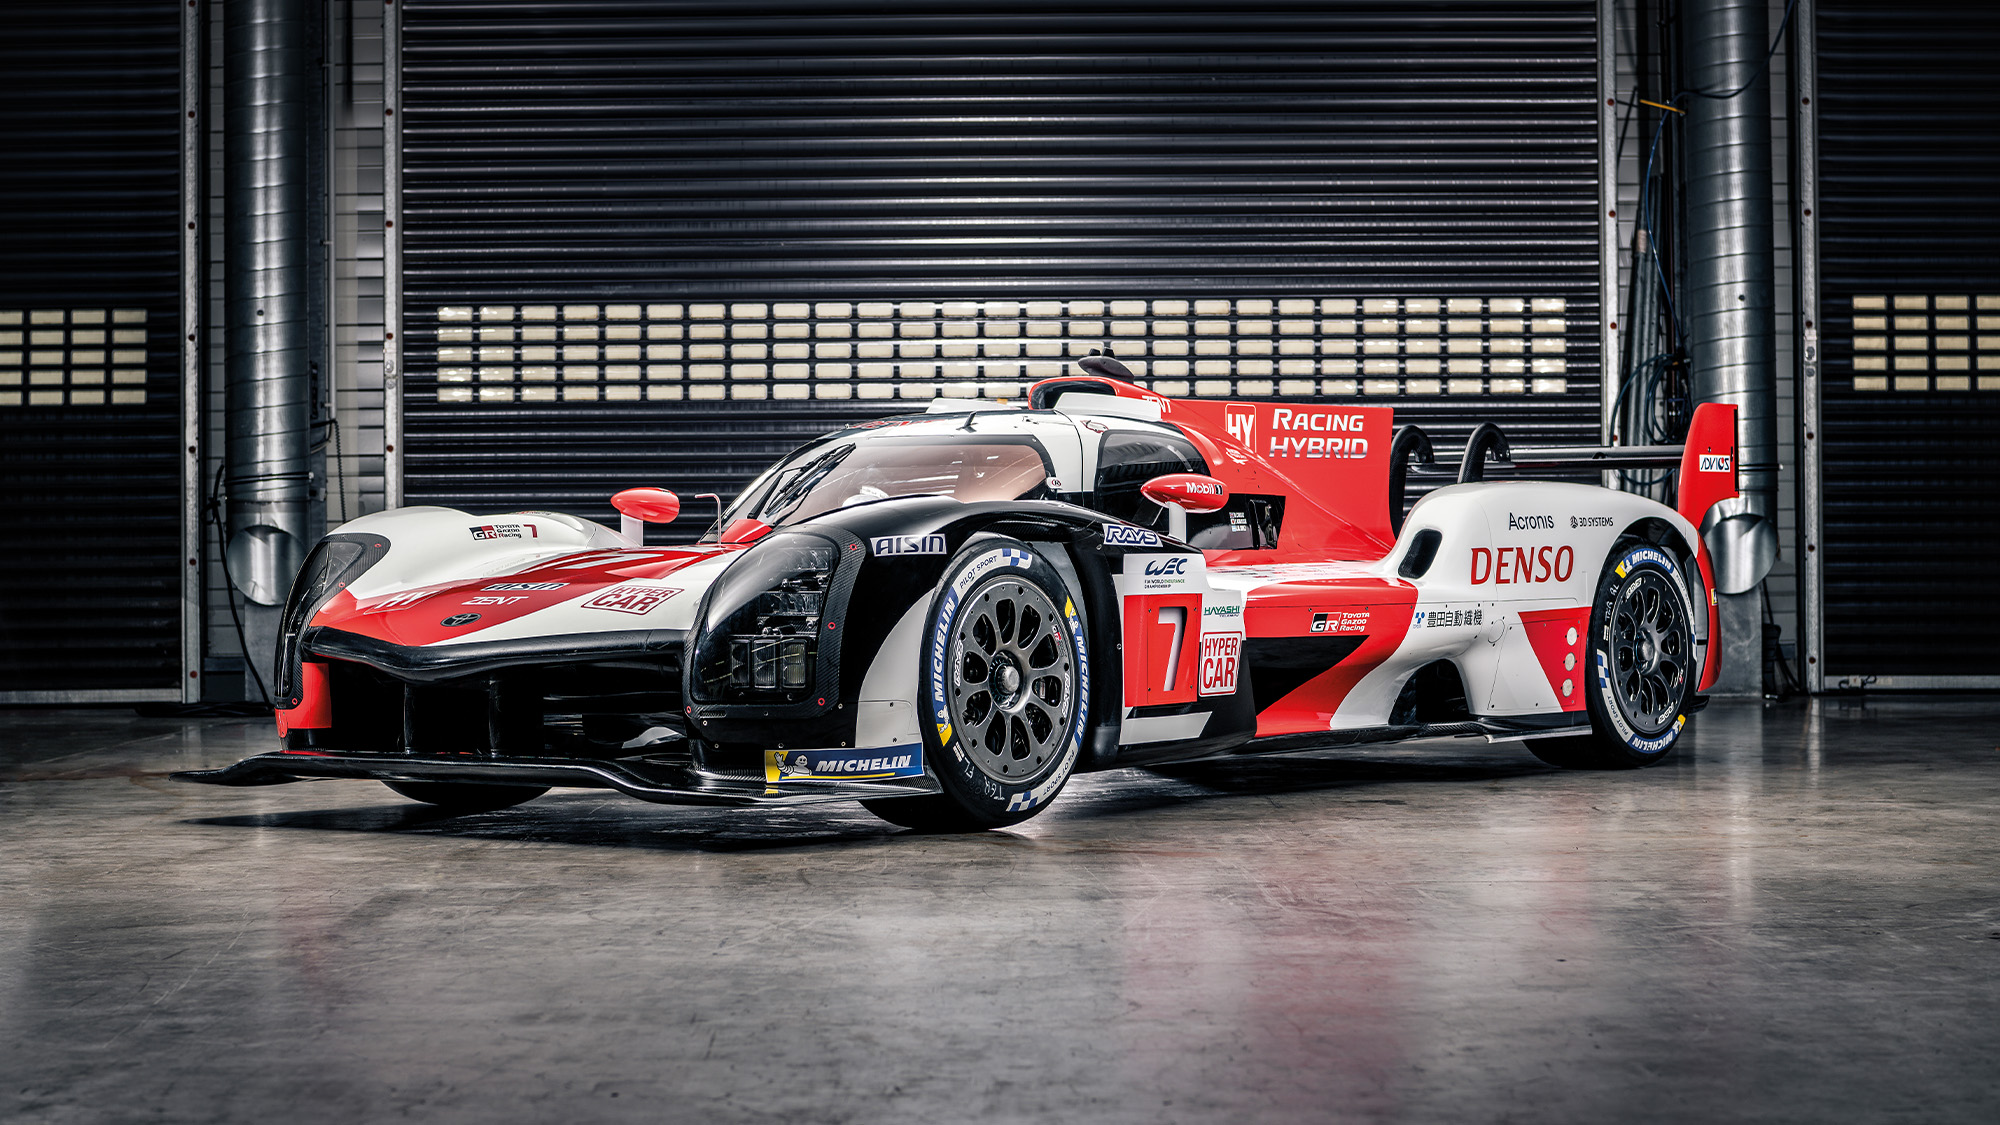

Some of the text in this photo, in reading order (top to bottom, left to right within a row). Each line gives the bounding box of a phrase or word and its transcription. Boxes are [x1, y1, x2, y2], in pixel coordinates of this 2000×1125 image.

[1227, 413, 1255, 450] HY
[1269, 436, 1368, 459] HYBRID
[1186, 482, 1215, 495] Mobil
[523, 524, 538, 538] 7
[1508, 512, 1555, 531] Acronis
[1579, 517, 1614, 527] 3D SYSTEMS
[472, 530, 497, 540] GR
[1106, 525, 1158, 545] RAYS
[1144, 557, 1188, 576] WEC
[1471, 545, 1574, 585] DENSO
[1631, 550, 1672, 571] MICHELIN
[960, 555, 998, 589] PILOT SPORT
[461, 596, 529, 605] ZENT
[592, 593, 660, 611] CAR
[614, 586, 675, 598] HYPER
[1204, 605, 1240, 616] HAYASHI
[1311, 620, 1338, 632] GR
[933, 596, 957, 702] MICHELIN
[1157, 606, 1188, 691] 7
[1204, 637, 1238, 657] HYPER
[1203, 657, 1236, 689] CAR
[1076, 635, 1089, 739] MICHELIN
[1607, 695, 1619, 718] SPORT
[1632, 731, 1673, 751] MICHELIN
[815, 755, 912, 772] MICHELIN
[1043, 749, 1076, 796] PILOT SPORT
